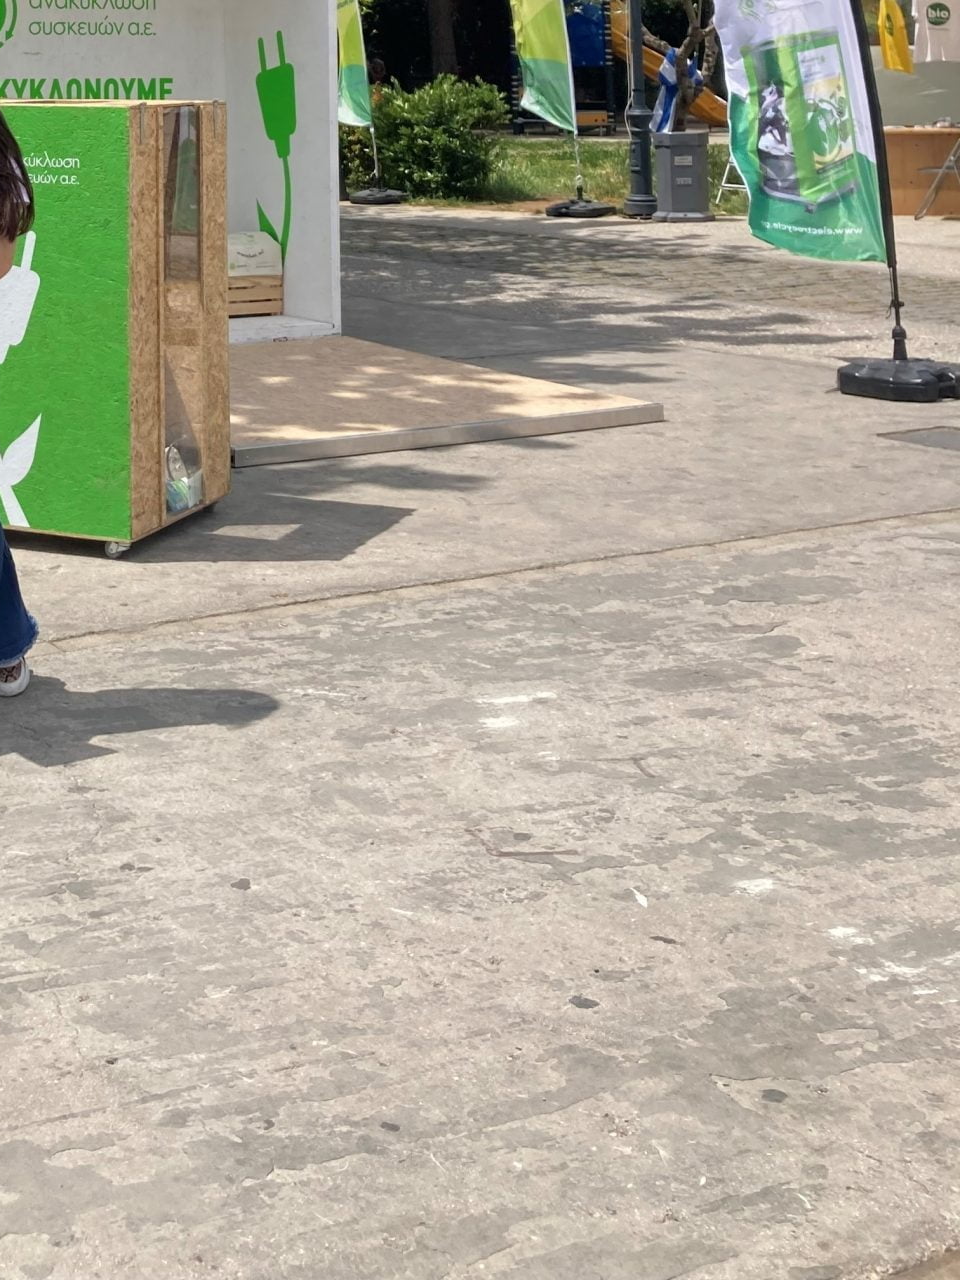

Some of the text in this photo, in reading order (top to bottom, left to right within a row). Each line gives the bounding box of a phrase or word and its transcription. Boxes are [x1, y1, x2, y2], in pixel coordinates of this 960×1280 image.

[928, 7, 949, 18] bio
[28, 15, 157, 36] συσκευών α.ε.
[23, 151, 80, 168] κύκλωση
[28, 170, 58, 184] ευών
